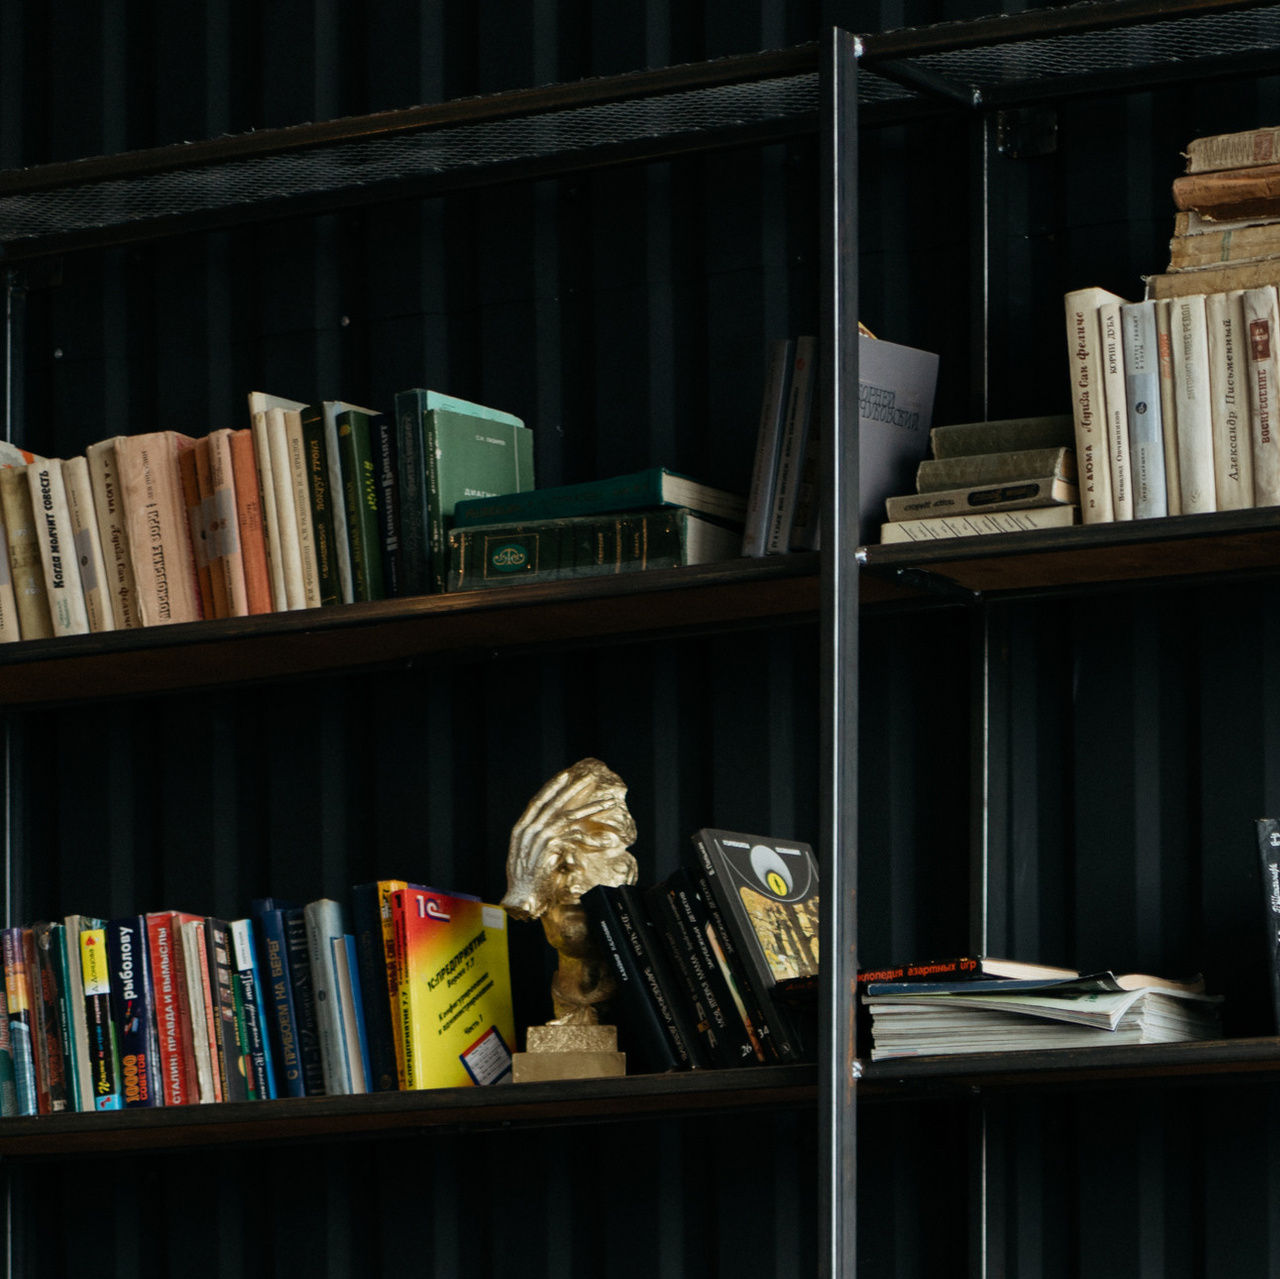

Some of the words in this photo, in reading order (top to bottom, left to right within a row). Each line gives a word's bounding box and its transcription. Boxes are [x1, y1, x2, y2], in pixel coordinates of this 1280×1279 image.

[1106, 316, 1115, 340] ДУБА
[1107, 343, 1117, 374] КОРНИ
[1222, 319, 1235, 405] Письменный
[1079, 391, 1093, 432] Луиза
[1257, 369, 1271, 443] ВОСКРЕСЕНИЕ
[377, 425, 394, 486] БОНАПАРТ
[1113, 411, 1124, 462] Овчинников
[1227, 412, 1239, 481] Александр
[1085, 445, 1094, 481] ДЮМА
[39, 470, 54, 511] совесть
[45, 514, 61, 554] молчит
[146, 510, 161, 542] ЗОРИ
[382, 487, 398, 551] НАПОЛЕОН
[49, 555, 65, 588] Когда
[149, 545, 170, 620] МОСКОВСКИЕ
[119, 926, 137, 1000] рыболову
[157, 927, 172, 993] ВЫМЫСЛЫ
[267, 937, 283, 977] БЕРЕГ
[906, 965, 958, 978] азартных
[960, 960, 977, 974] игр
[164, 996, 173, 1004] И
[275, 982, 287, 999] НА
[165, 1007, 178, 1051] ПРАВДА
[278, 1003, 297, 1065] ПРИБОЕМ
[122, 1055, 139, 1103] 10000
[138, 1054, 147, 1100] СОВЕТОВ
[168, 1053, 182, 1104] СТАЛИН:
[286, 1070, 298, 1080] С
